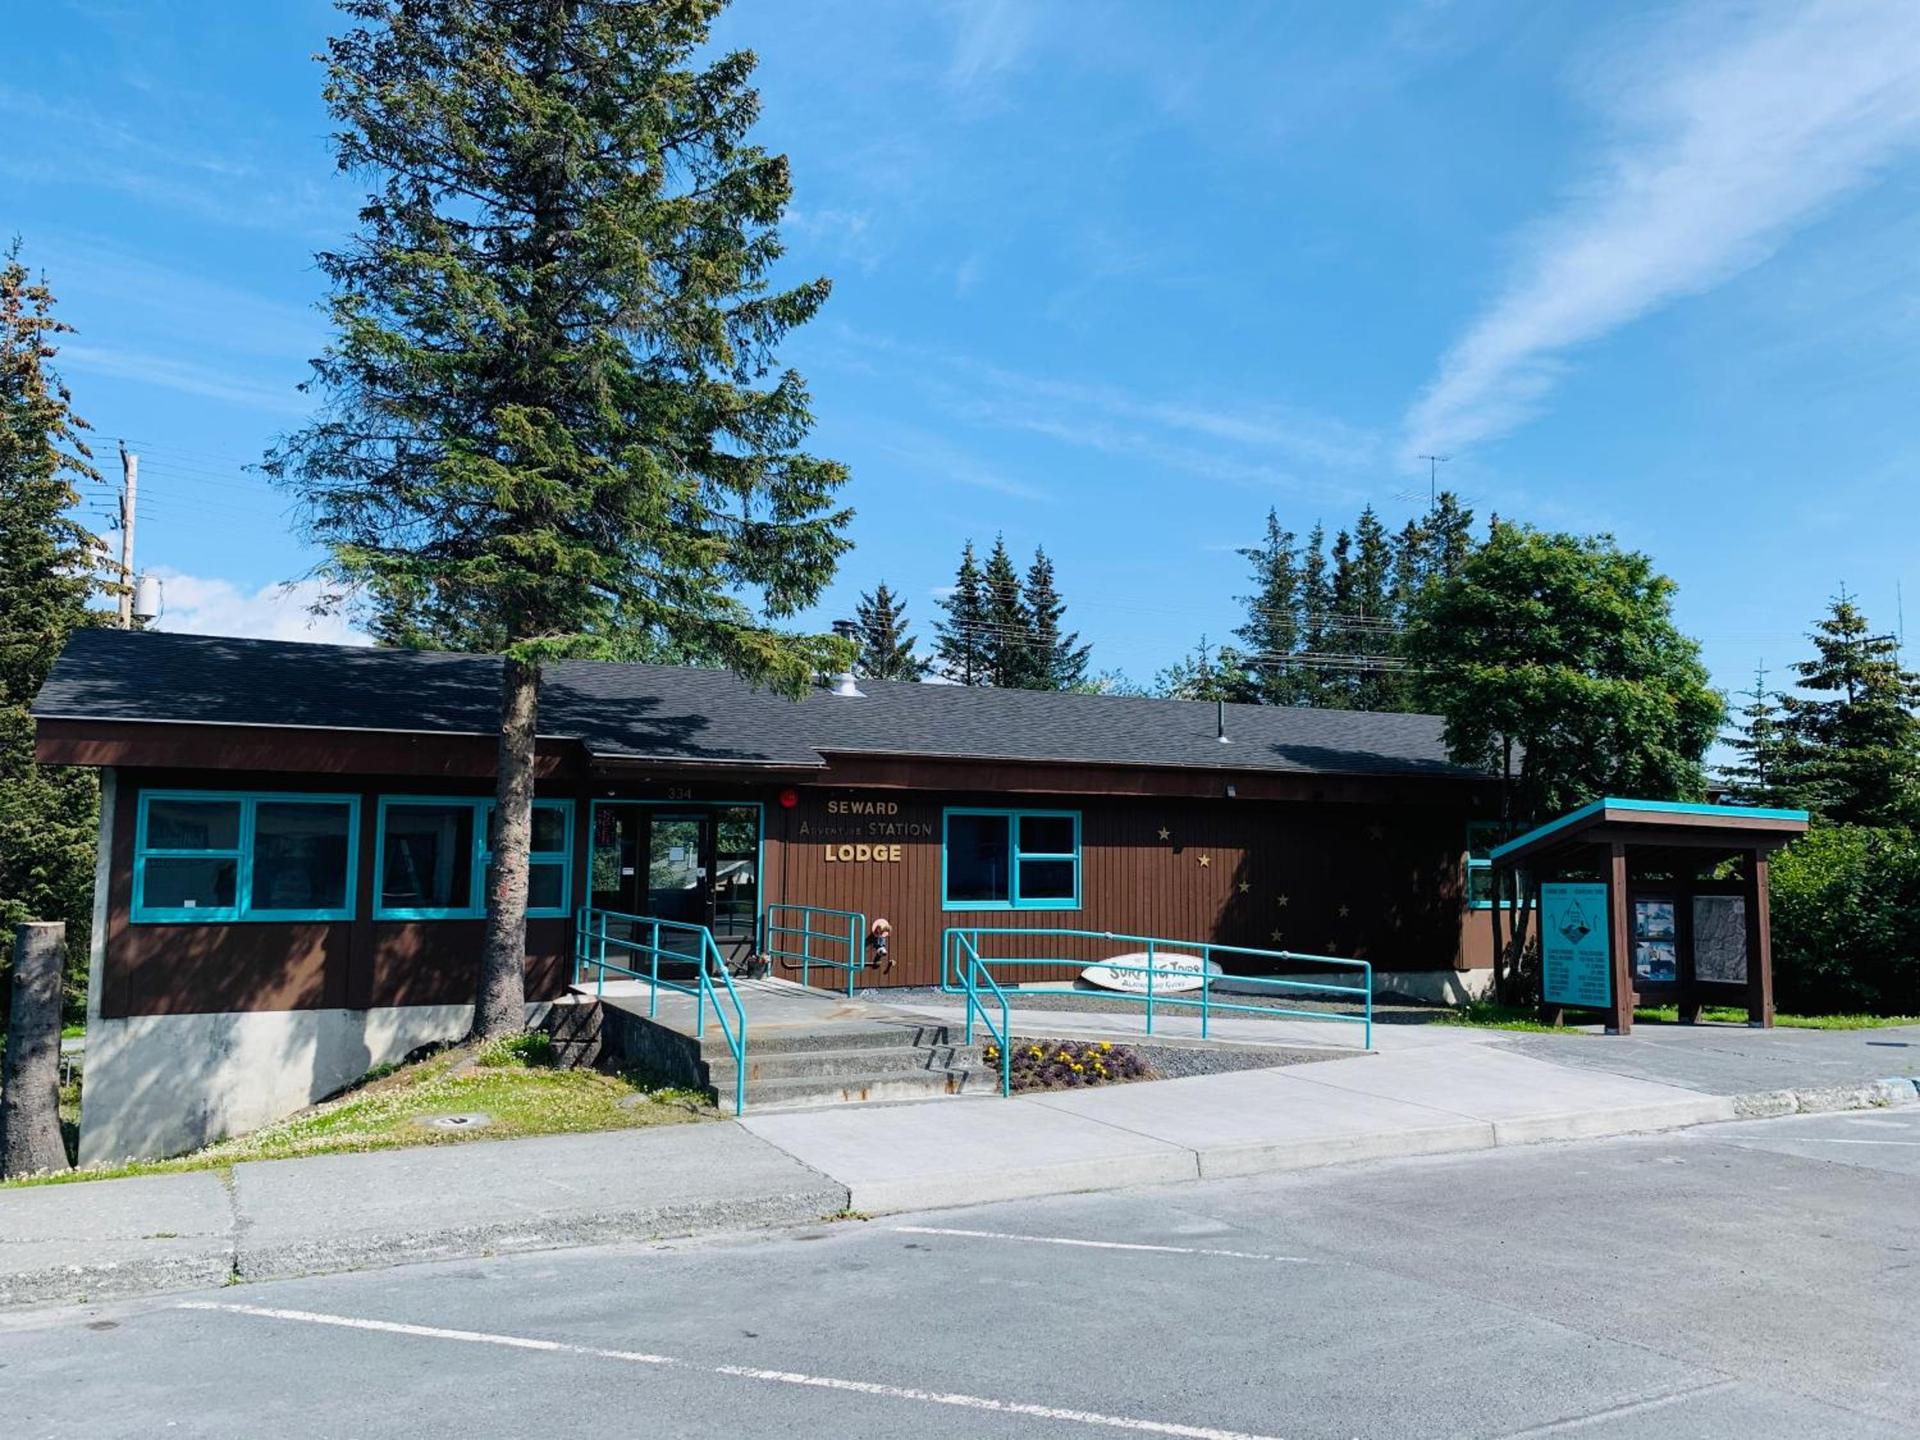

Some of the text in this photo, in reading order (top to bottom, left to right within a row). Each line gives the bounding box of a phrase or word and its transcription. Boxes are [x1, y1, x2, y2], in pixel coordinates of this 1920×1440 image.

[667, 787, 692, 800] 334
[827, 800, 898, 815] SEWARD
[799, 821, 932, 836] AVENTE STATION
[824, 844, 901, 862] LODGE
